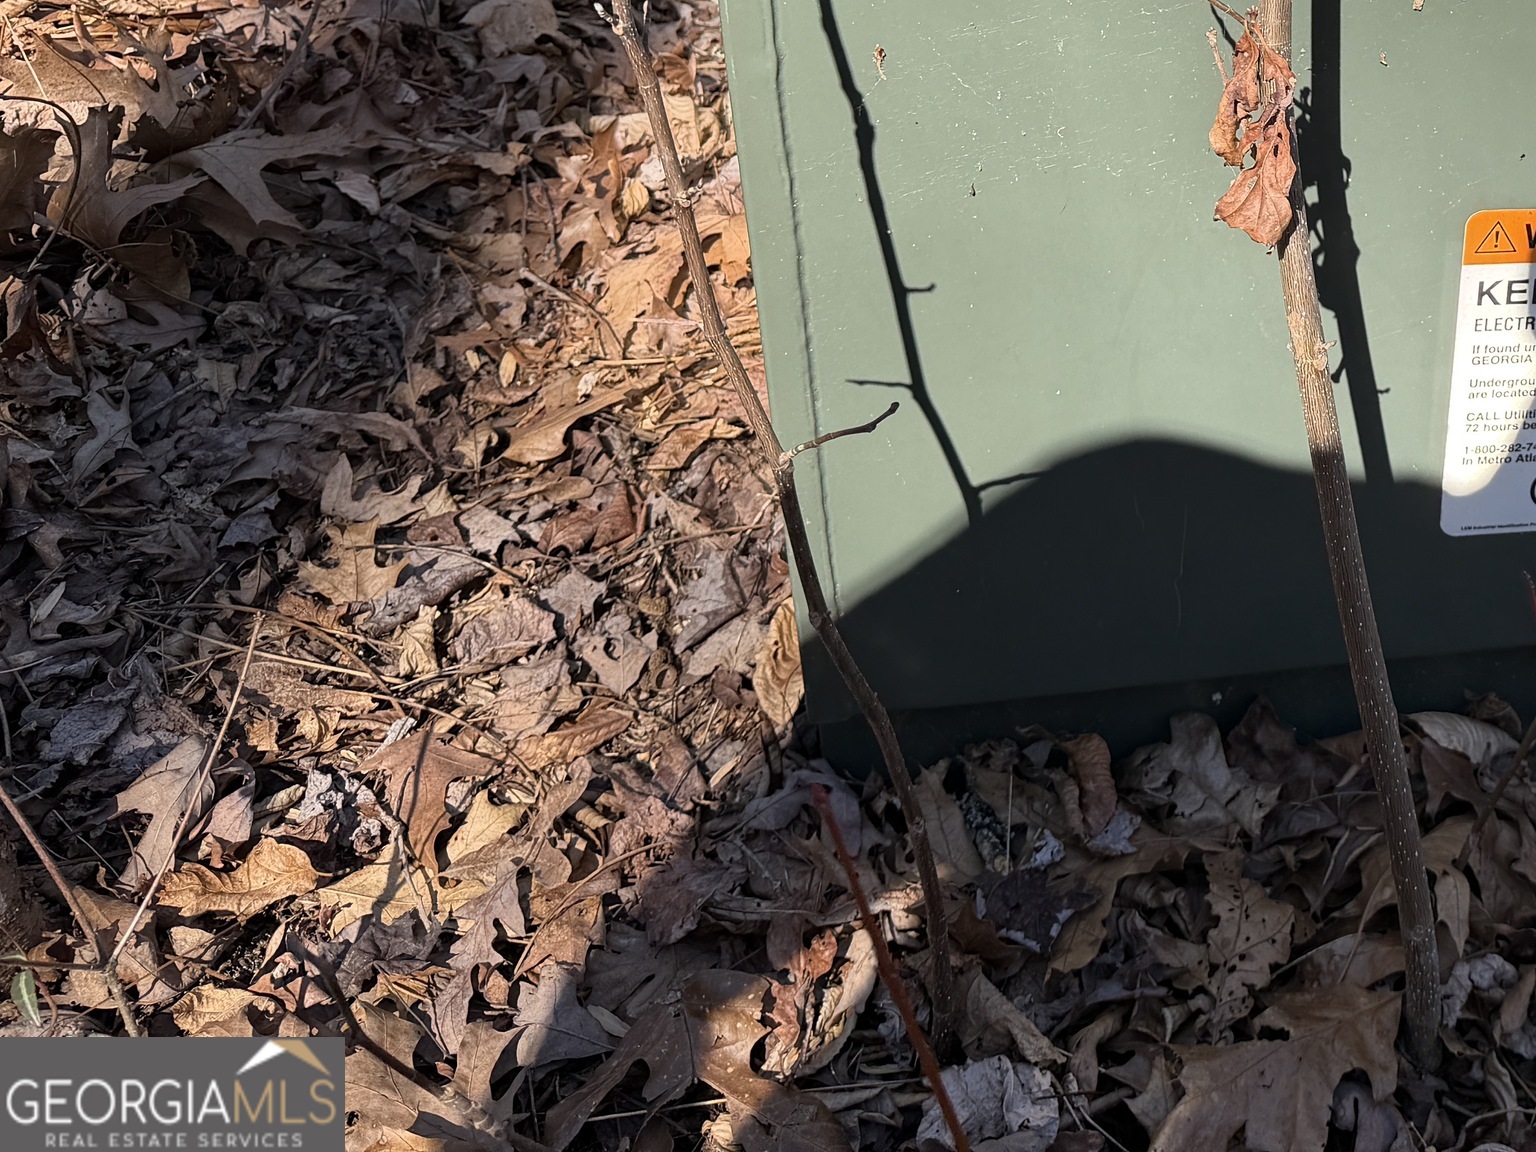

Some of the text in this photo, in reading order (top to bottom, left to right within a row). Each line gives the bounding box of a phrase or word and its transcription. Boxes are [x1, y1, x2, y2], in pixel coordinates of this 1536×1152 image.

[1472, 344, 1480, 355] If
[1484, 343, 1521, 354] found
[1471, 354, 1533, 366] GEORGIA
[1468, 390, 1488, 400] are
[1491, 387, 1536, 399] located
[1466, 411, 1501, 422] CALL
[1465, 423, 1479, 433] 72
[1483, 421, 1519, 432] hours
[1462, 457, 1473, 466] In
[1477, 454, 1512, 465] Metro
